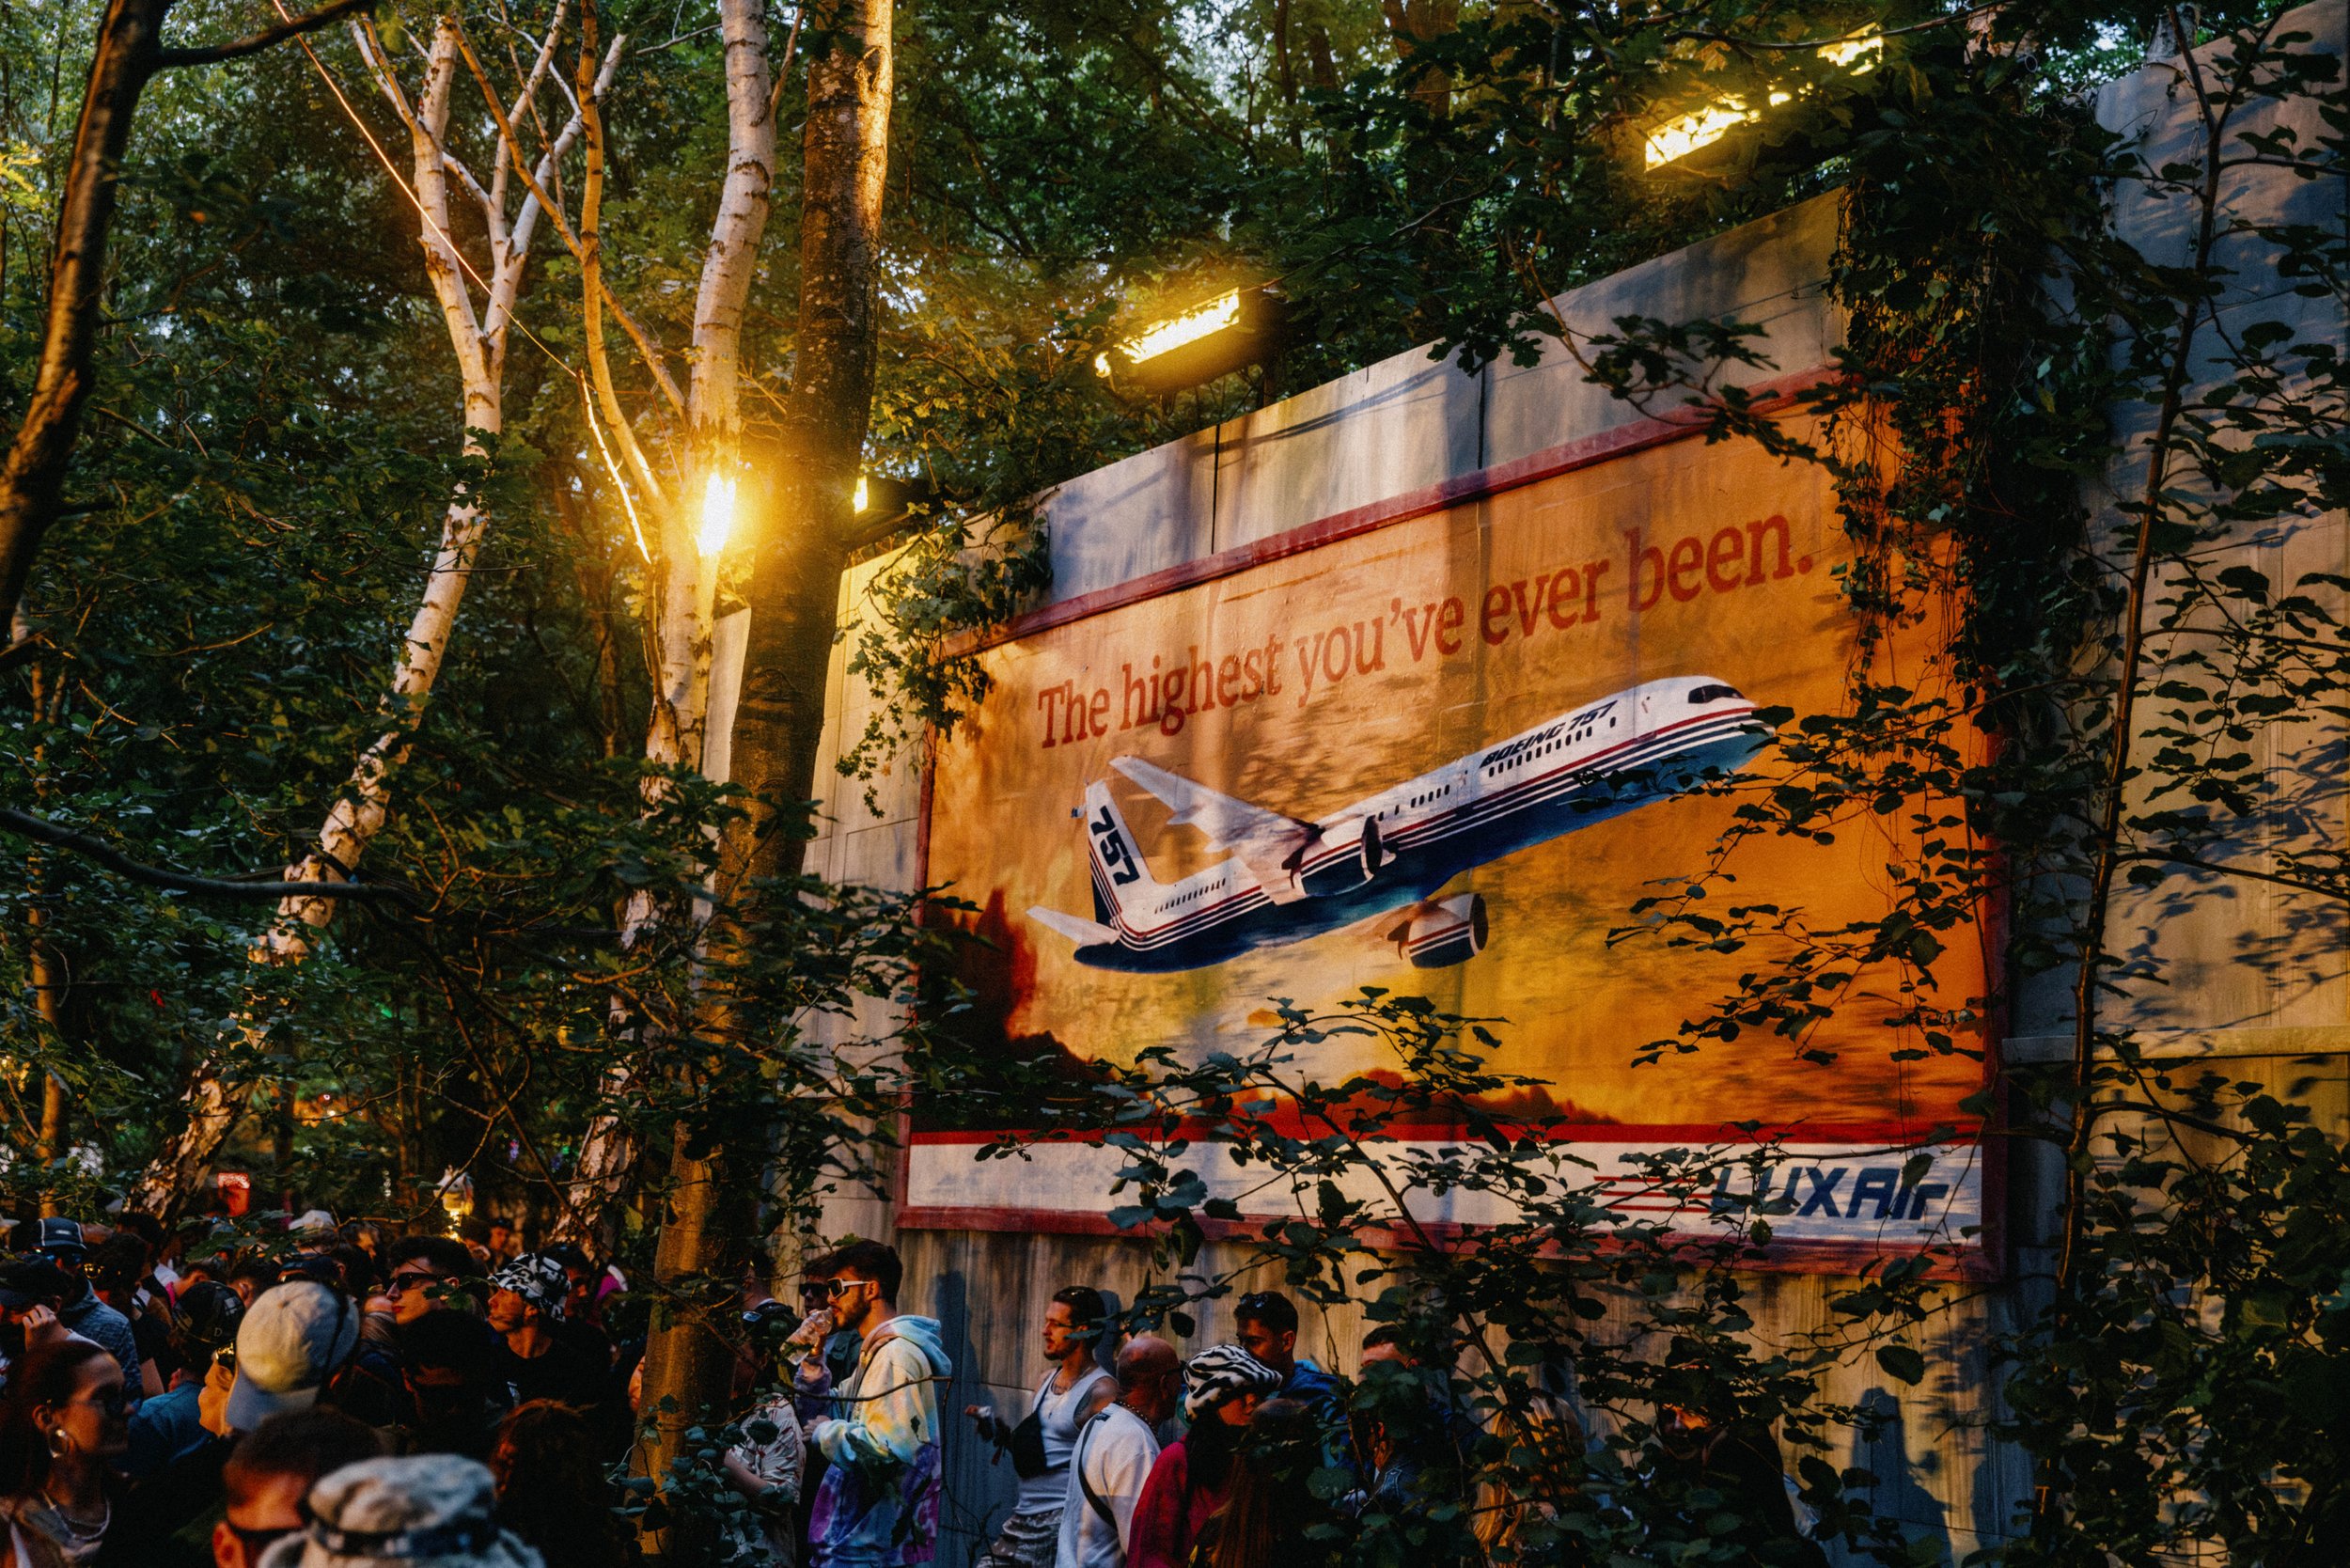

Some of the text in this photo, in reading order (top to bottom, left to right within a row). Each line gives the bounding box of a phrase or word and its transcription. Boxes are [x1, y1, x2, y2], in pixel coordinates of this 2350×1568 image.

[1038, 514, 1812, 748] The highest you've ever been.
[1479, 699, 1619, 769] BOEING 757
[1090, 805, 1140, 886] 757
